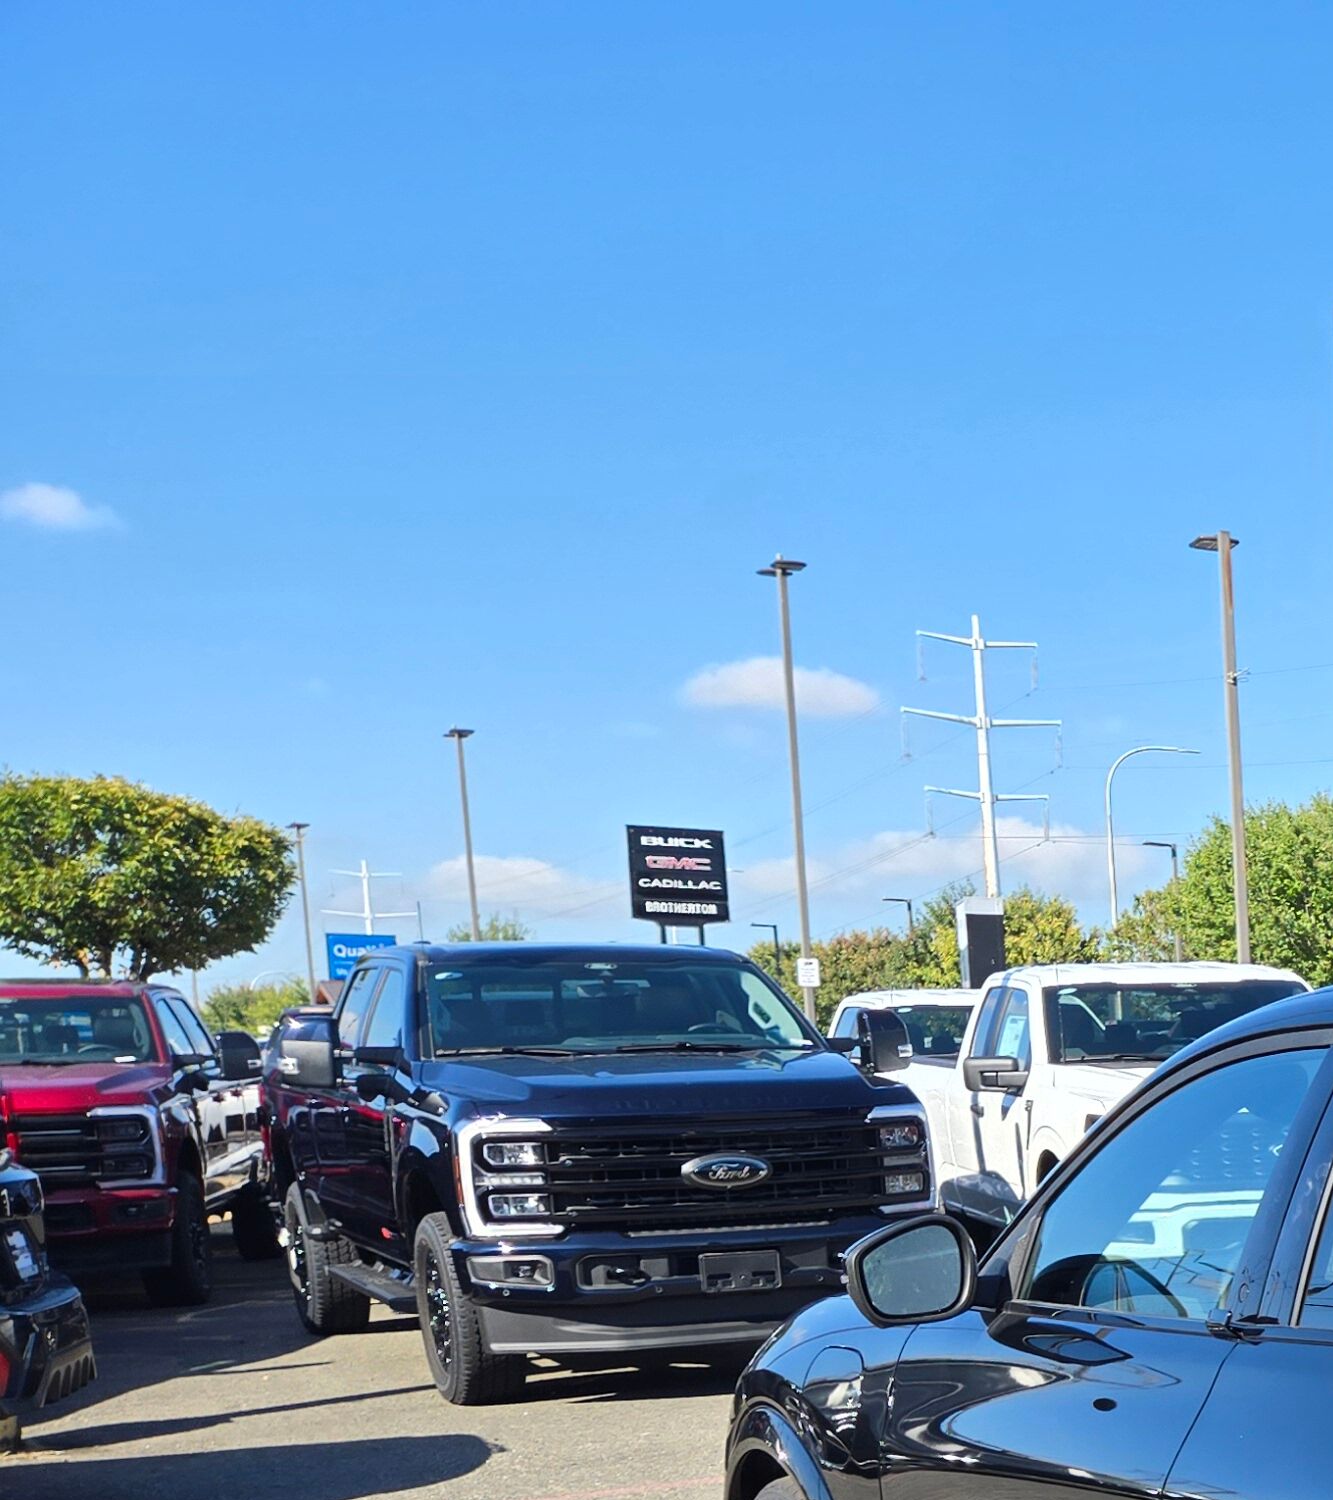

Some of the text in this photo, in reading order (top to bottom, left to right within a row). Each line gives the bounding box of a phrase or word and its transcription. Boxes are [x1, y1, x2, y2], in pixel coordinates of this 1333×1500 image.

[640, 835, 714, 849] BUICK
[645, 855, 712, 871] GMC
[638, 878, 722, 890] CADILLAC
[708, 1163, 751, 1180] Ford
